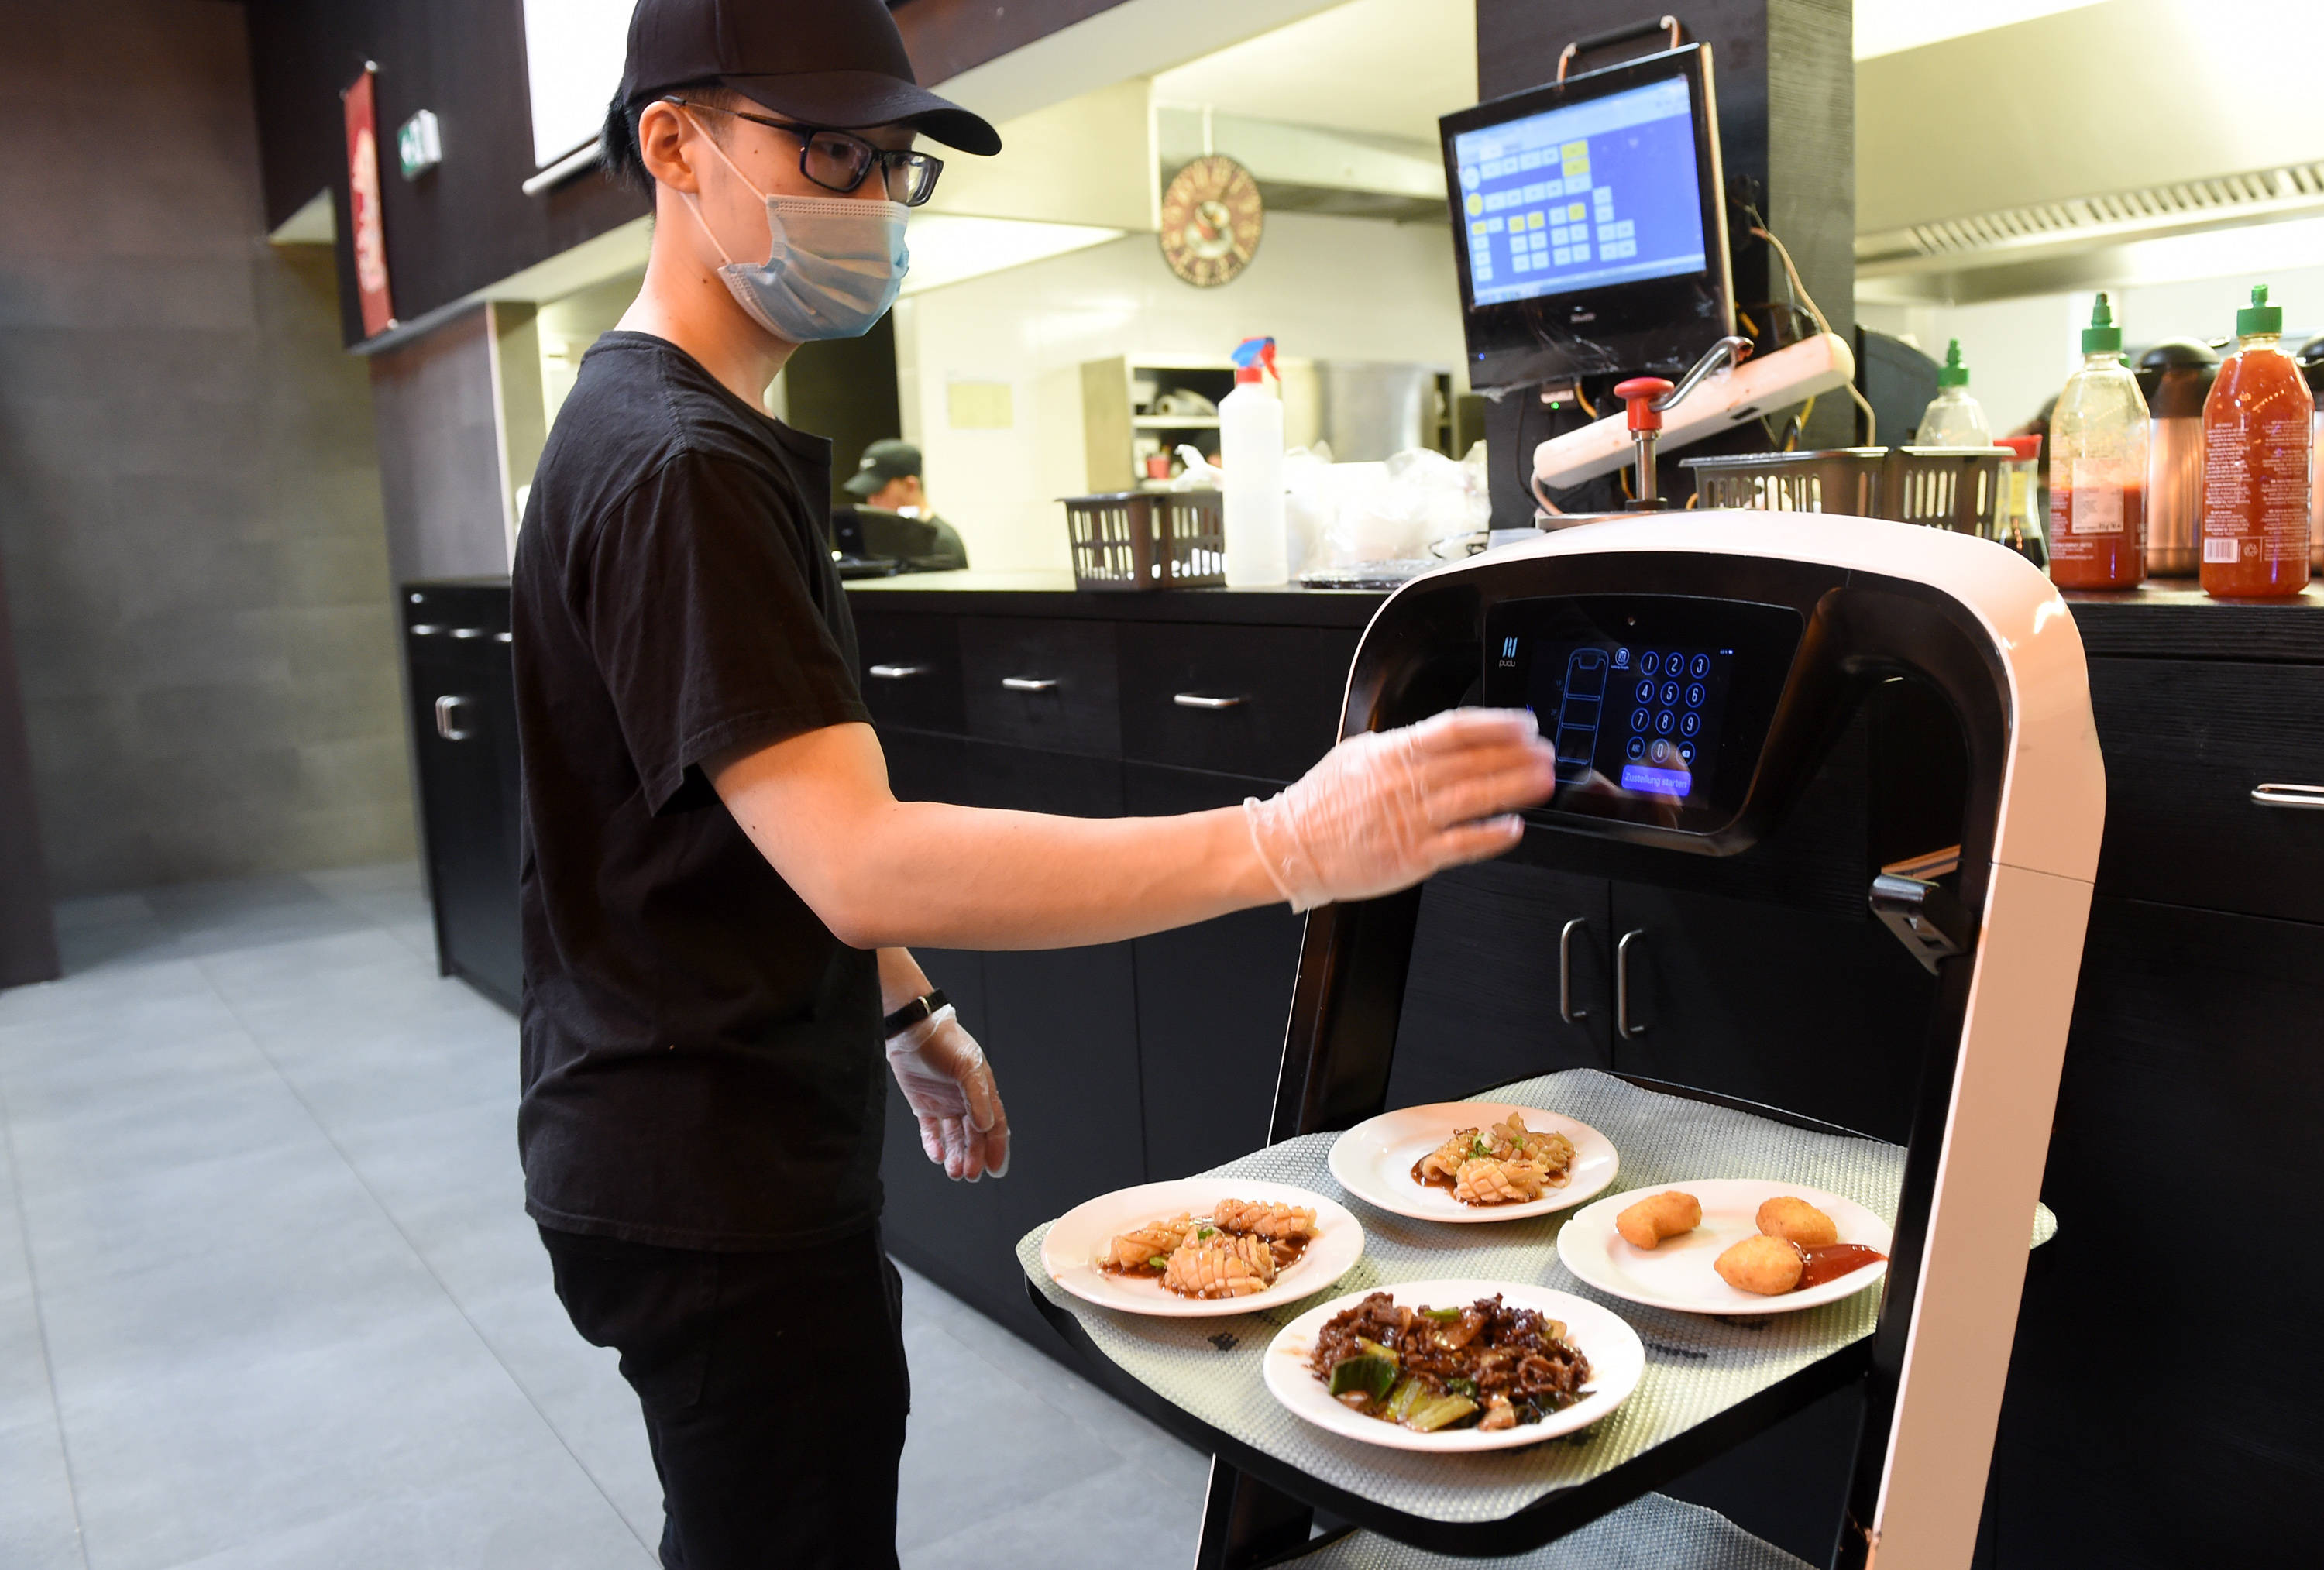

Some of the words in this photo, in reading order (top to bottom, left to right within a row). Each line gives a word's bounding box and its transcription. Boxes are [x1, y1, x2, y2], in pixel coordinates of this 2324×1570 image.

[1499, 660, 1515, 668] pudu
[1648, 656, 1652, 670] 1
[1671, 657, 1678, 672] 2
[1697, 658, 1703, 673] 3
[1642, 685, 1648, 699] 4
[1666, 685, 1673, 700] 5
[1692, 688, 1698, 703] 6
[1638, 712, 1644, 727] 7
[1662, 714, 1669, 729] 8
[1687, 716, 1693, 731] 9
[1657, 743, 1663, 758] 0
[1624, 771, 1661, 788] Zustellung
[1662, 778, 1687, 788] starten
